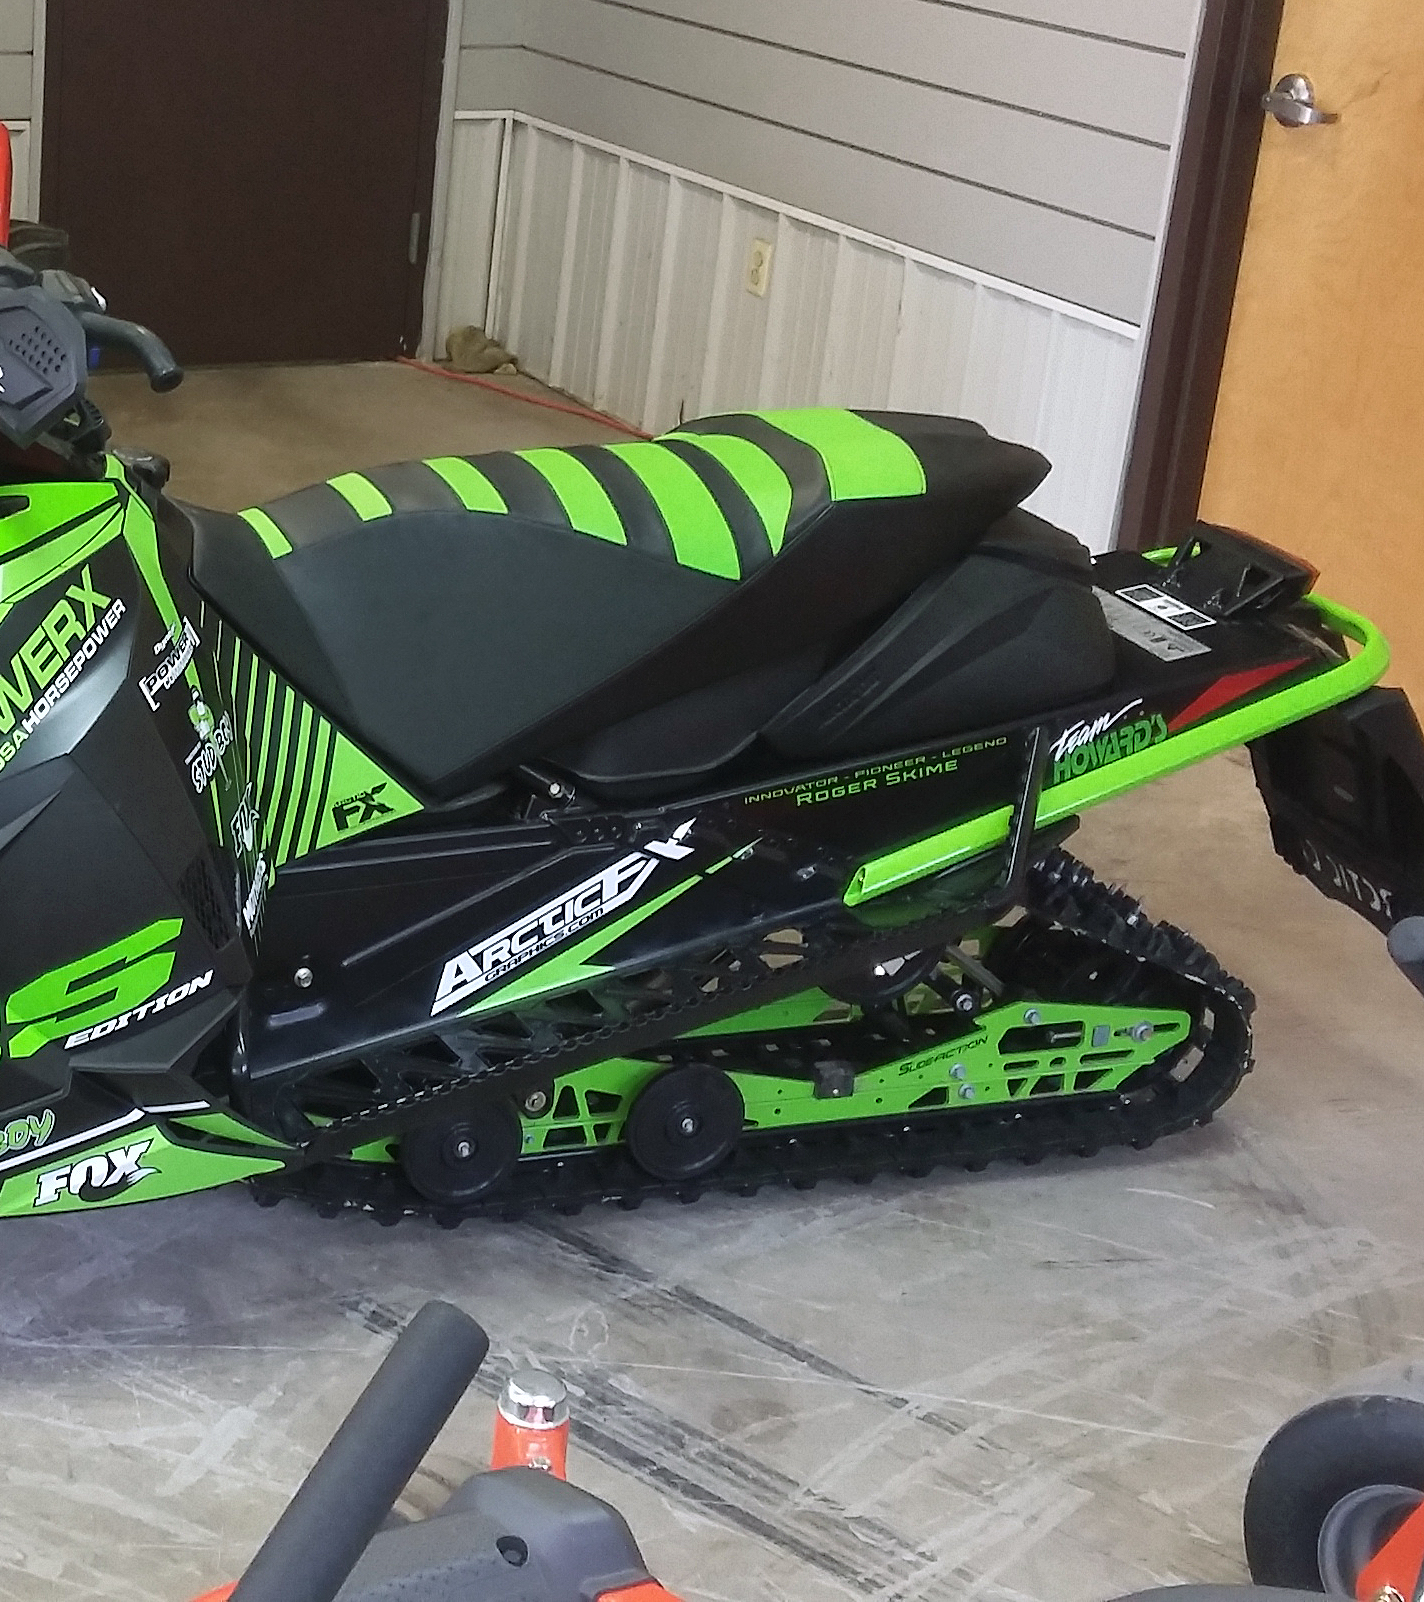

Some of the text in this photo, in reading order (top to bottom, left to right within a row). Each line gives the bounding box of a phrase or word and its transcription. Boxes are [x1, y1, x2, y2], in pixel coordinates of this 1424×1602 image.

[744, 775, 839, 805] INNOVATOR
[854, 755, 926, 780] PIONEER
[941, 736, 1008, 759] LEGEND
[796, 759, 959, 807] ROGER SKIME
[1054, 714, 1168, 785] HOWARD'S
[332, 782, 394, 831] FX
[64, 969, 214, 1050] EDITION
[33, 1139, 163, 1208] FOX
